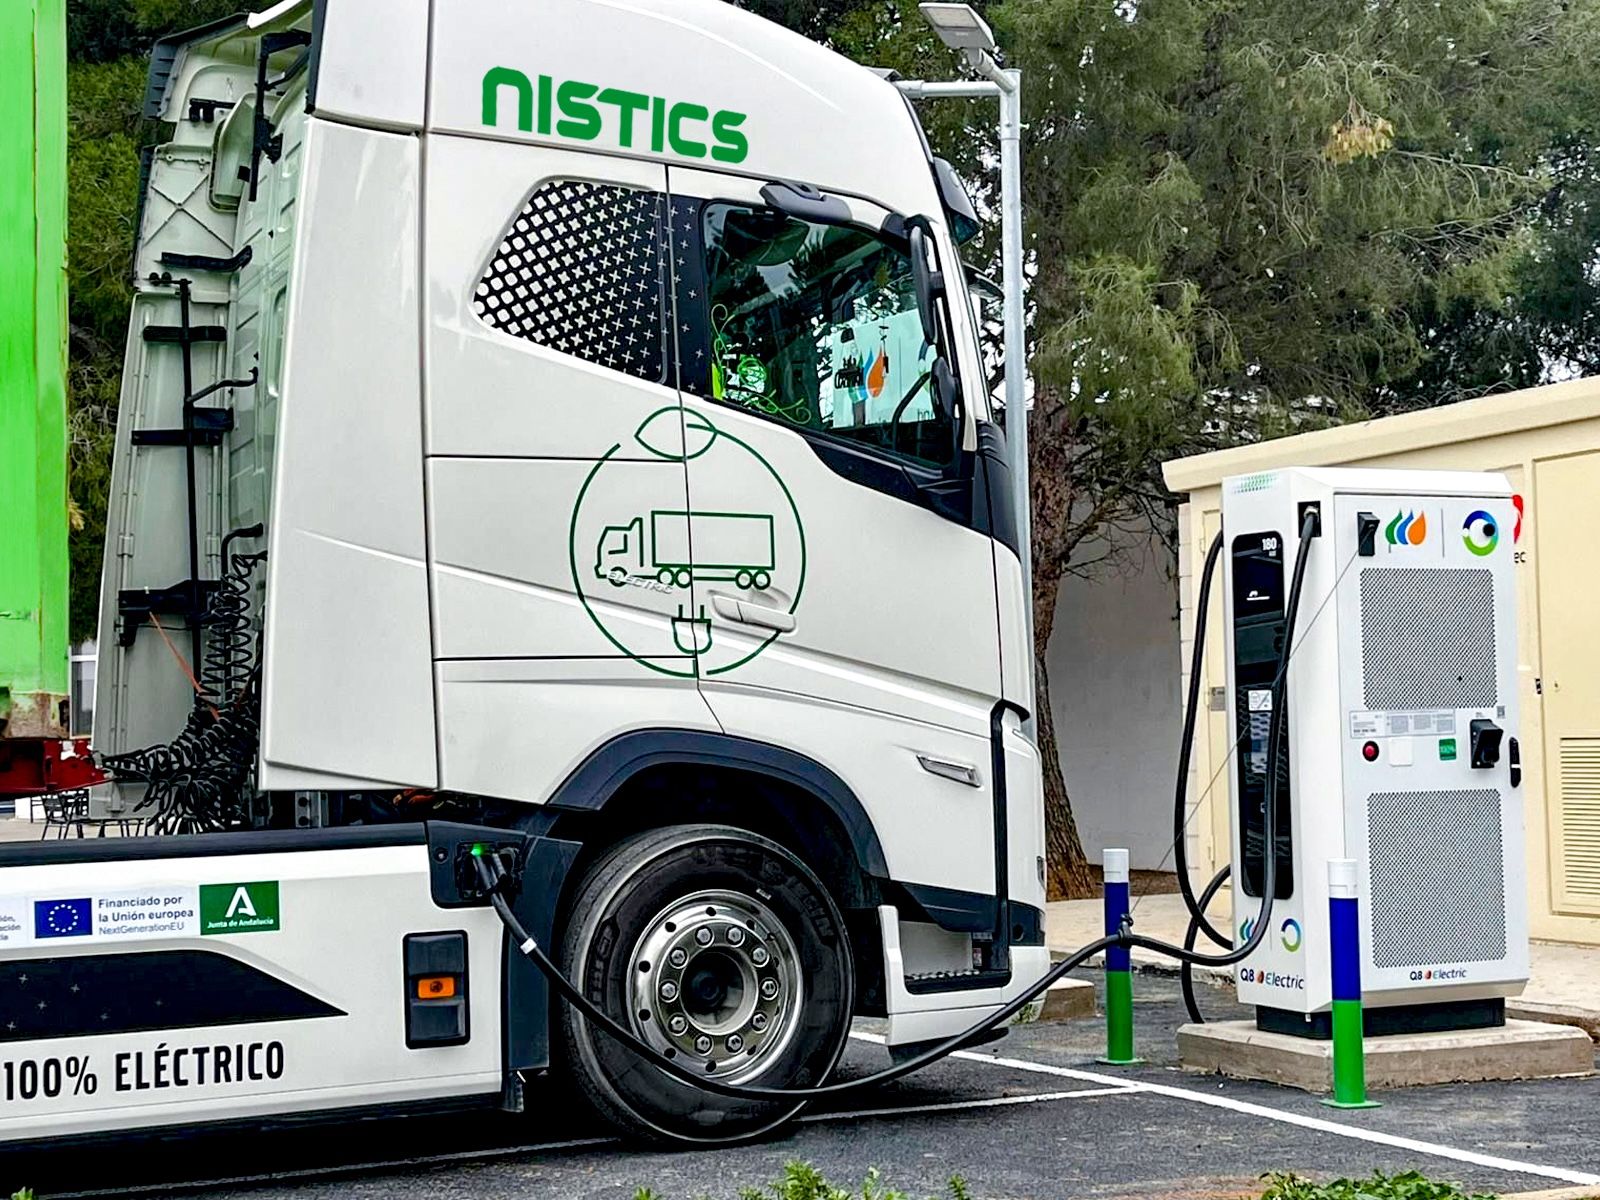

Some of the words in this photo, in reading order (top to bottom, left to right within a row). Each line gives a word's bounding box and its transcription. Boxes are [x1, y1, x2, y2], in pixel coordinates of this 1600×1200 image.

[482, 66, 748, 164] NISTICS
[98, 896, 161, 909] Financiado
[163, 895, 183, 906] por
[98, 913, 108, 923] la
[111, 910, 146, 922] Unión
[148, 909, 194, 920] europea
[99, 921, 185, 936] NextGenerationEU
[207, 921, 228, 929] Junta
[228, 919, 238, 928] de
[1240, 968, 1255, 982] Q8
[1265, 972, 1305, 990] Electric
[1410, 970, 1423, 981] Q8
[1433, 968, 1467, 980] Electric
[4, 1056, 97, 1100] 100%
[115, 1041, 284, 1091] ELÉCTRICO
